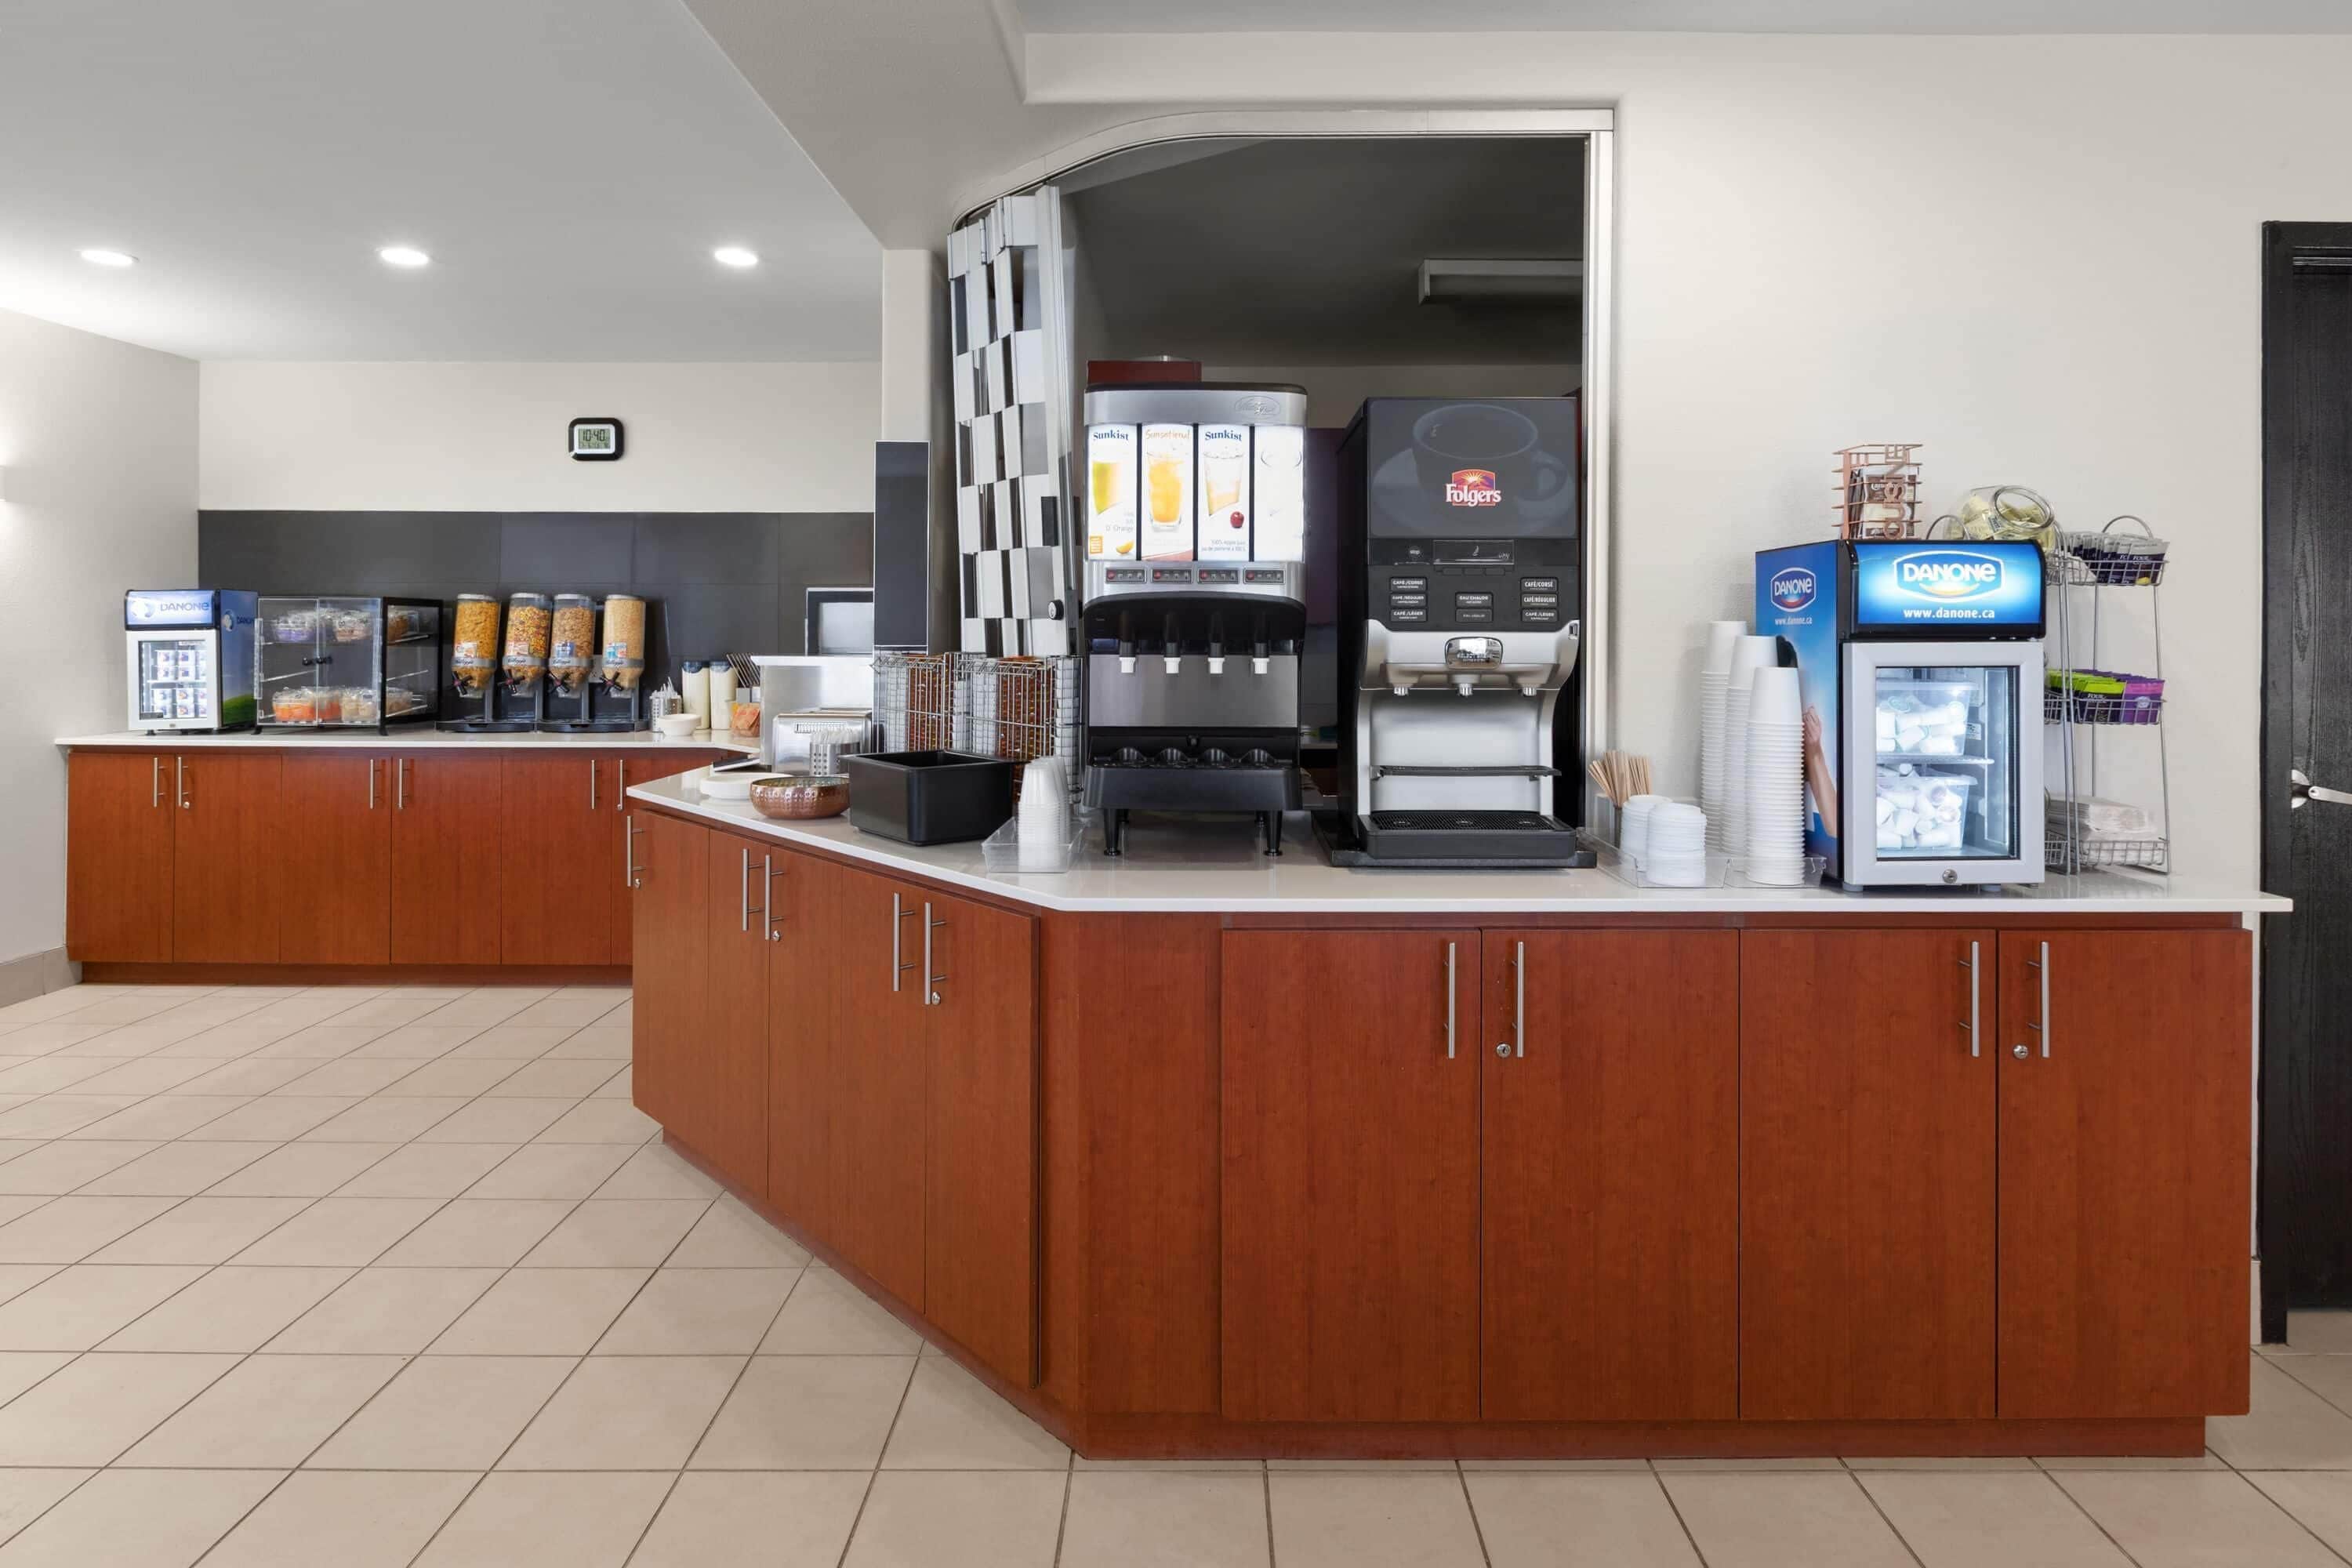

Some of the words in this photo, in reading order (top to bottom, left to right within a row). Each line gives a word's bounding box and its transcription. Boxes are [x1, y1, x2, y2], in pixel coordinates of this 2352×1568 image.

[1093, 430, 1130, 441] Sunkist
[1205, 430, 1243, 441] Sunkist
[1446, 483, 1502, 507] Folgers
[1904, 608, 1995, 619] www.danone.ca
